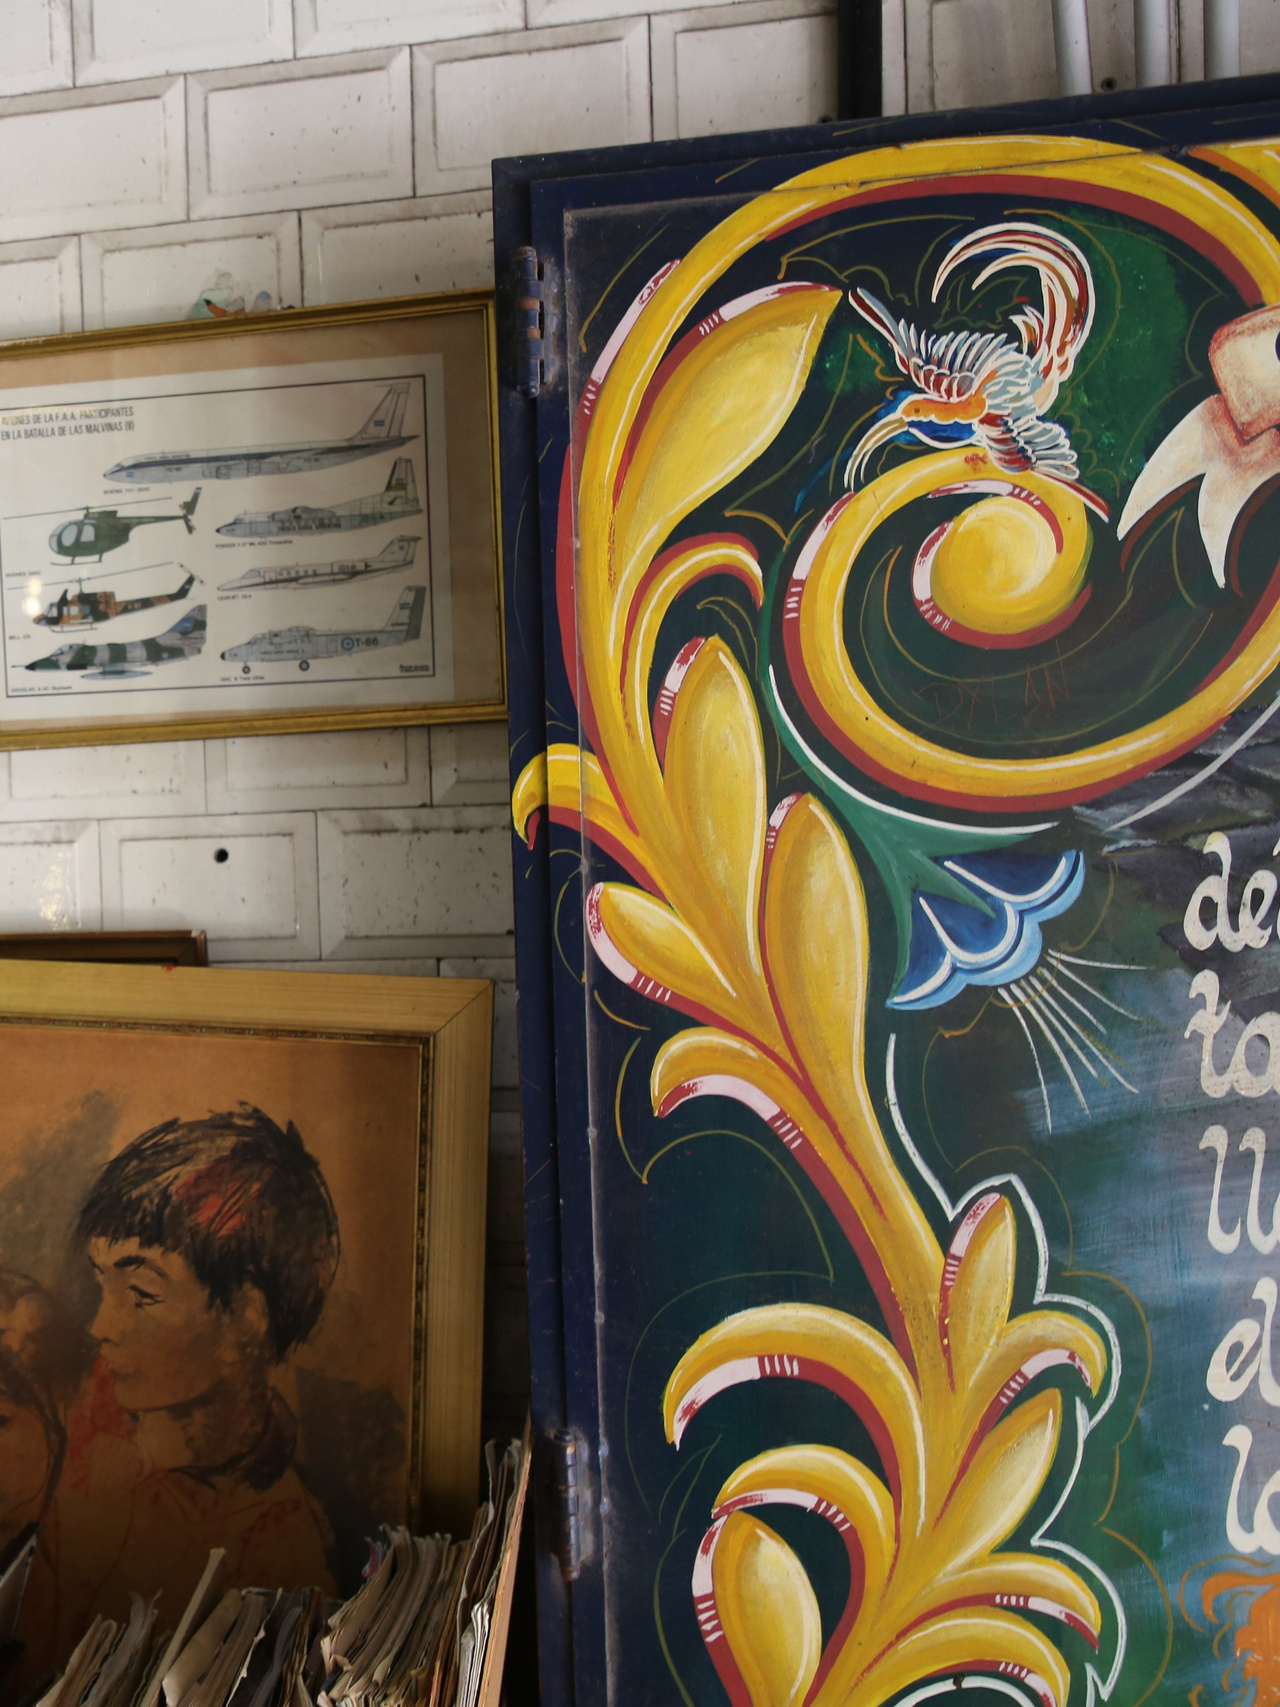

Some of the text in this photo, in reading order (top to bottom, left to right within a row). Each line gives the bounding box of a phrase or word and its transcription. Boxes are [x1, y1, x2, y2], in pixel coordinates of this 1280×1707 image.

[32, 414, 42, 424] DE
[43, 413, 54, 424] LA
[79, 406, 134, 420] PARTICIPANTES
[1, 429, 11, 441] EN
[12, 429, 22, 440] LA
[23, 426, 56, 439] BATALLA
[57, 425, 67, 437] DE
[69, 424, 84, 436] LAS
[85, 421, 124, 434] MALVINAS
